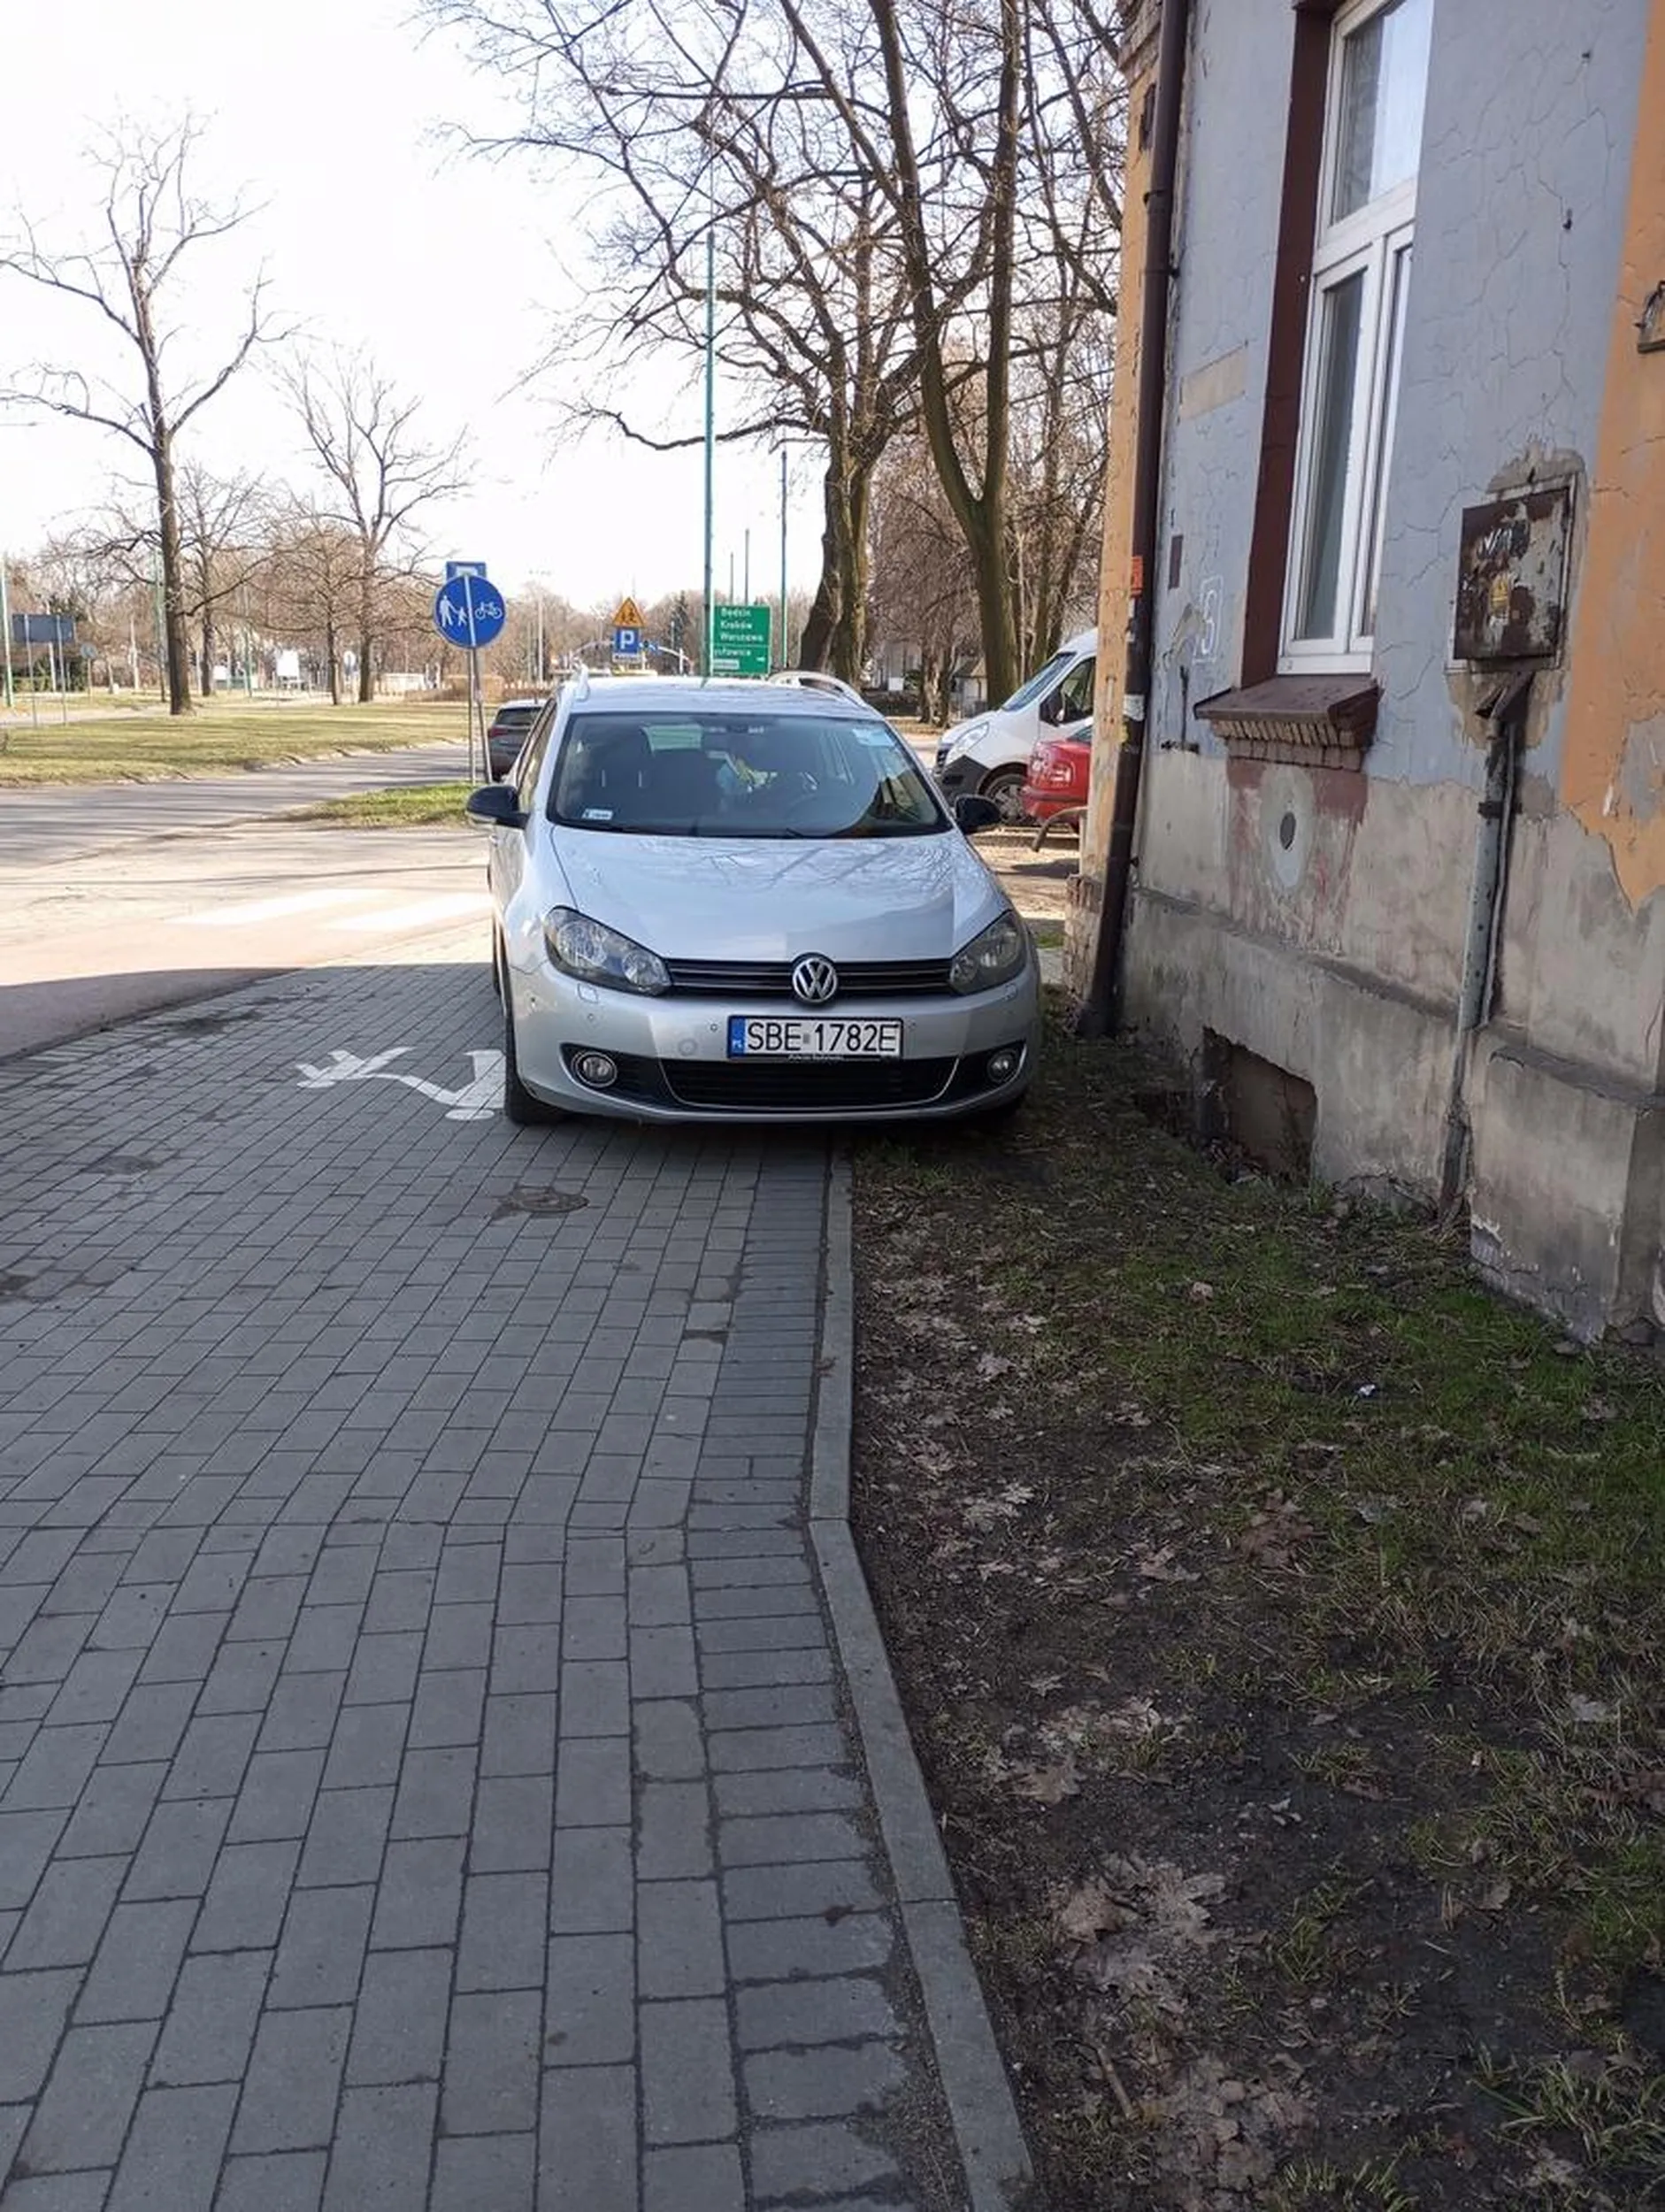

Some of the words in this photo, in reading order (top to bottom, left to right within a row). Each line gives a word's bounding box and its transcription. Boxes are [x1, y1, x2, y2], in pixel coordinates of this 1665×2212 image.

[720, 619, 753, 629] Kraków
[620, 629, 635, 650] P
[720, 632, 764, 641] Warszawa
[748, 1021, 802, 1051] SBE
[814, 1023, 900, 1052] 1782E
